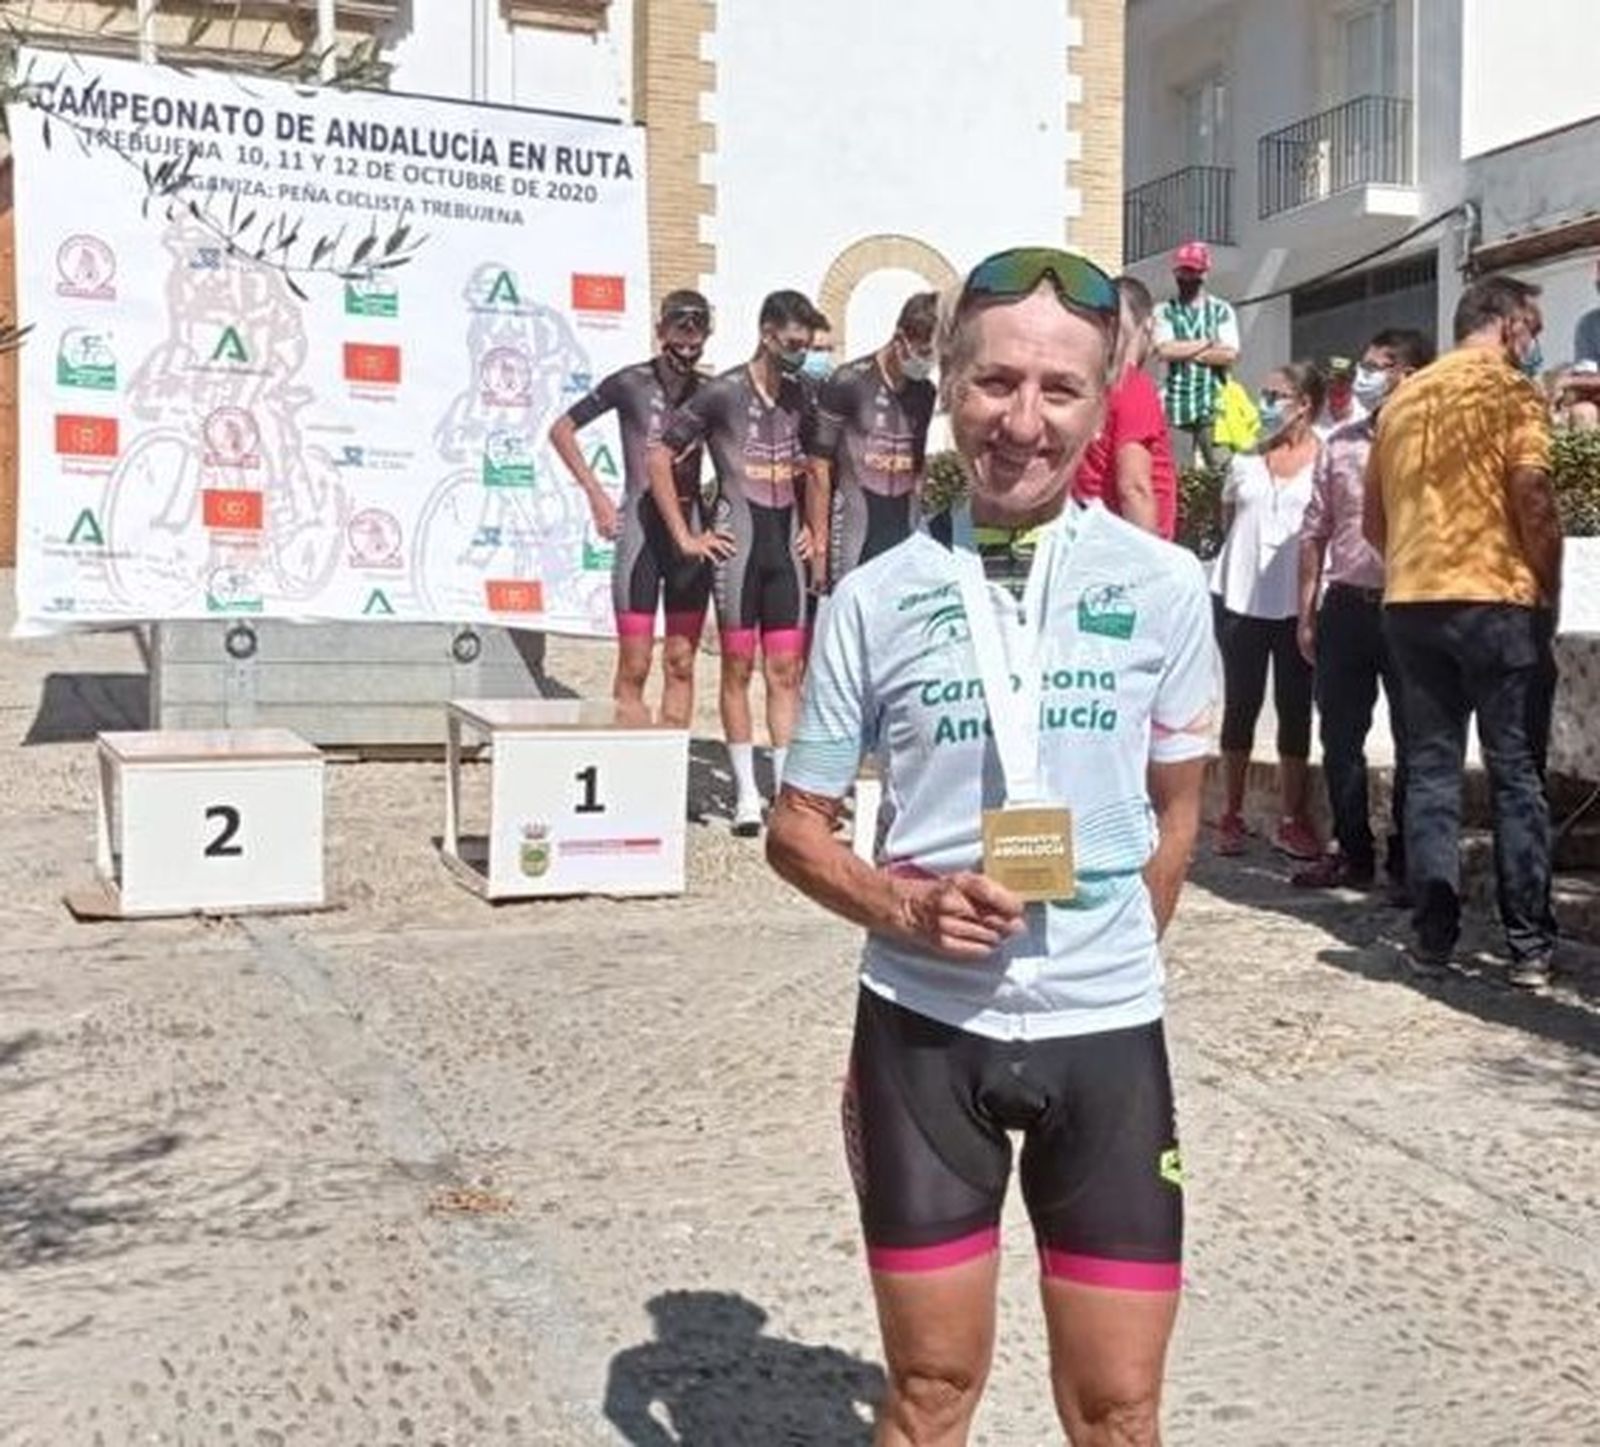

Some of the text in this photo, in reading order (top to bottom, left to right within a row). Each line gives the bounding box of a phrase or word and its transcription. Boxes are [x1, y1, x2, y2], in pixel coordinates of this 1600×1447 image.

[36, 83, 634, 180] CAMPEONATO DE ANDALUCÍA EN RUTA
[84, 127, 598, 204] TREBUJENA 10, 11 Y 12 DE OCTUBRE DE 2020
[168, 172, 525, 226] GANIZA: PEÑA CICLISTA TREBUJENA
[574, 766, 606, 814] 1
[203, 805, 243, 857] 2
